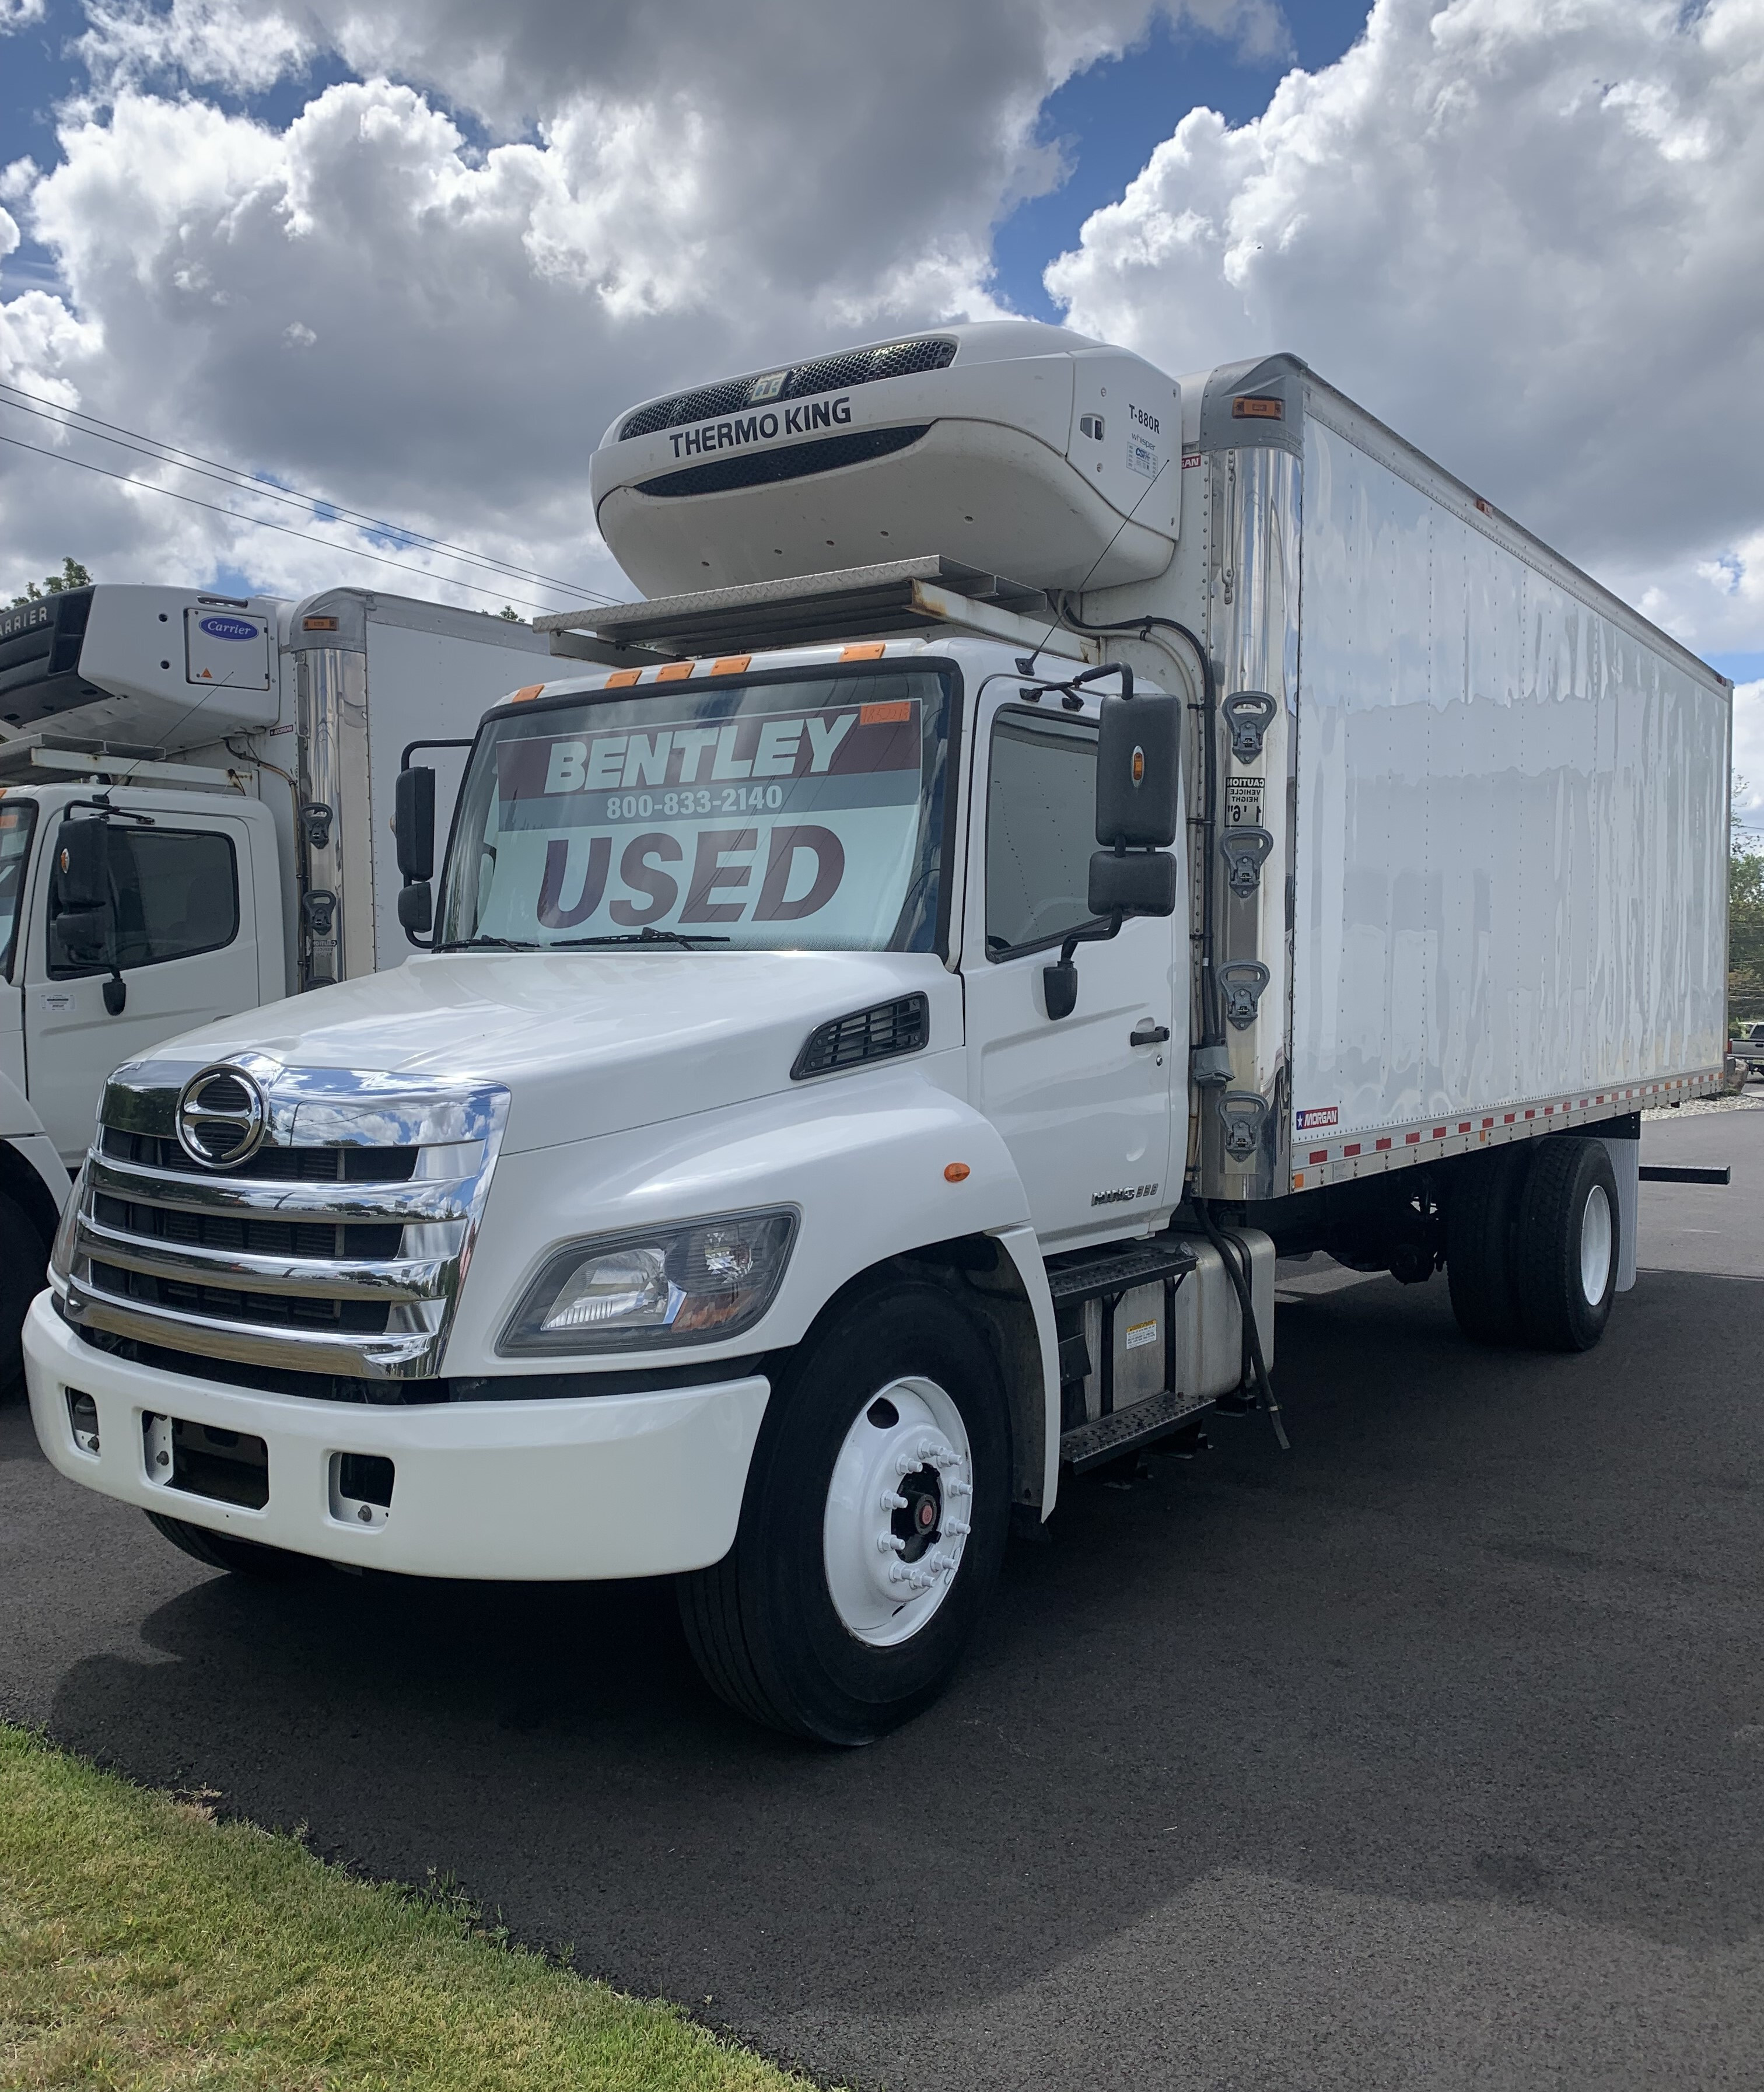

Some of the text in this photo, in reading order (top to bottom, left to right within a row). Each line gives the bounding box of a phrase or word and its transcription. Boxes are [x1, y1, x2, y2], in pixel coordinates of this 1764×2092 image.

[670, 397, 852, 458] THERMO KING
[1129, 403, 1160, 434] T-880R
[1132, 432, 1156, 451] whisper
[207, 621, 251, 635] Carrier
[544, 713, 859, 794] BENTLEY
[607, 785, 783, 820] 800-833-2140
[537, 824, 845, 929] USED
[1304, 1110, 1337, 1127] MORGAN
[1091, 1186, 1135, 1206] HINO
